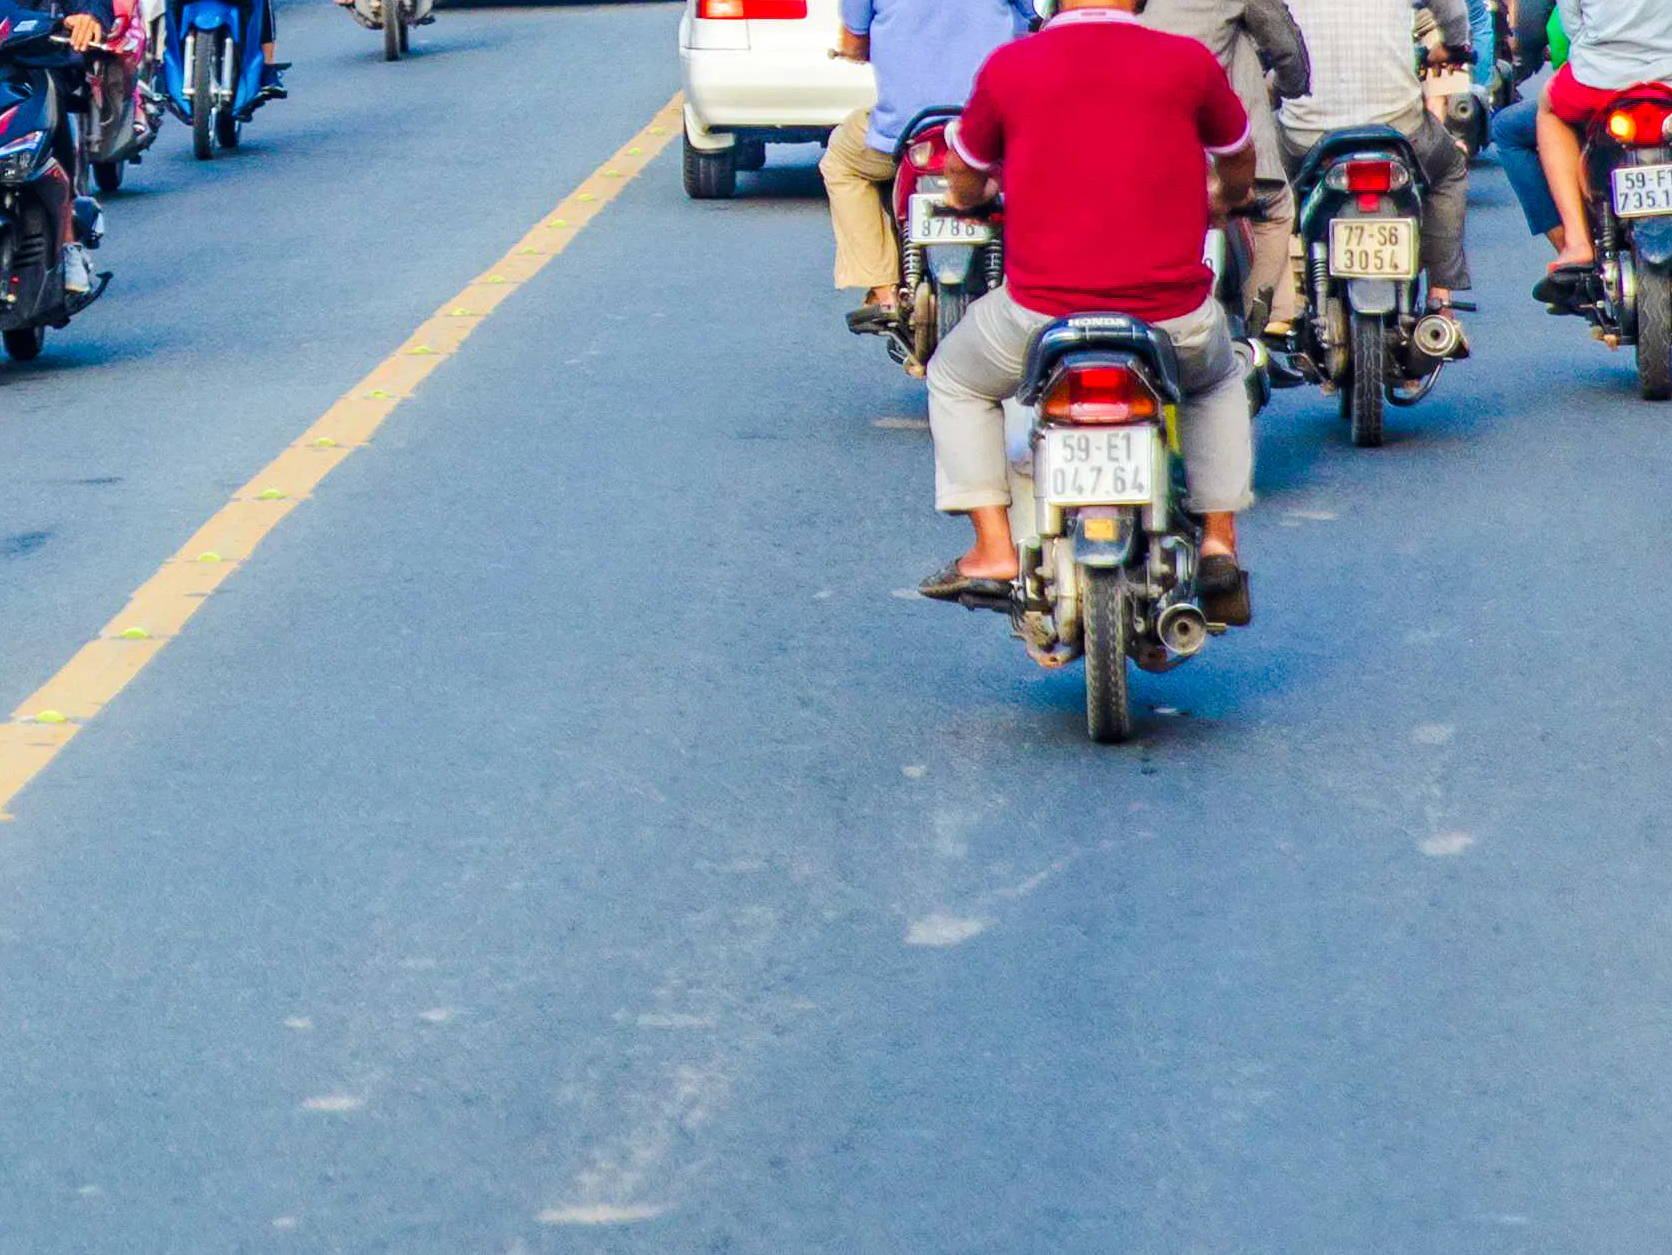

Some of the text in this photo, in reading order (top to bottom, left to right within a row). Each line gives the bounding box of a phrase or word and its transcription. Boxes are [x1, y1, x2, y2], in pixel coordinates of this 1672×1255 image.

[1343, 225, 1400, 247] 77-S6
[1343, 248, 1401, 271] 3054
[1067, 318, 1131, 327] HONDA
[1062, 433, 1133, 464] 59-E1
[1053, 465, 1145, 496] 047.64
